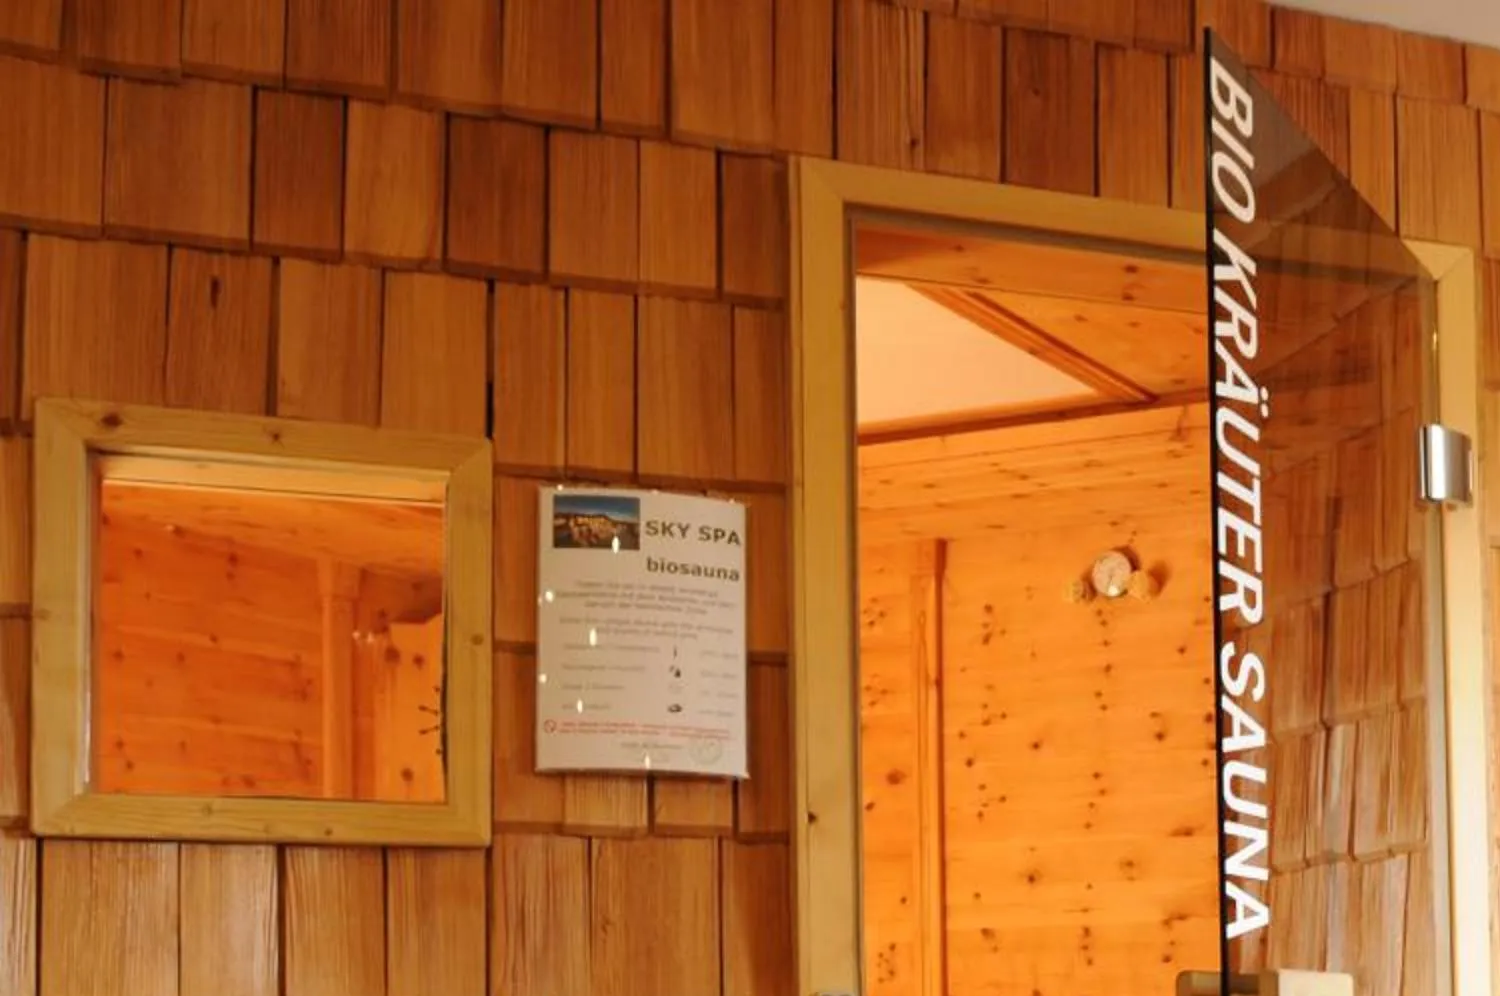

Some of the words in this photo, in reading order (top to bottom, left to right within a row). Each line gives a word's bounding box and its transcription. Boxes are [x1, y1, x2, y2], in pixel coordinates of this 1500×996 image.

[1210, 56, 1256, 224] BIO
[1213, 228, 1269, 626] KRÄUTER
[645, 519, 692, 539] SKY
[698, 525, 741, 546] SPA
[646, 556, 740, 582] biosauna
[1220, 641, 1270, 939] SAUNA
